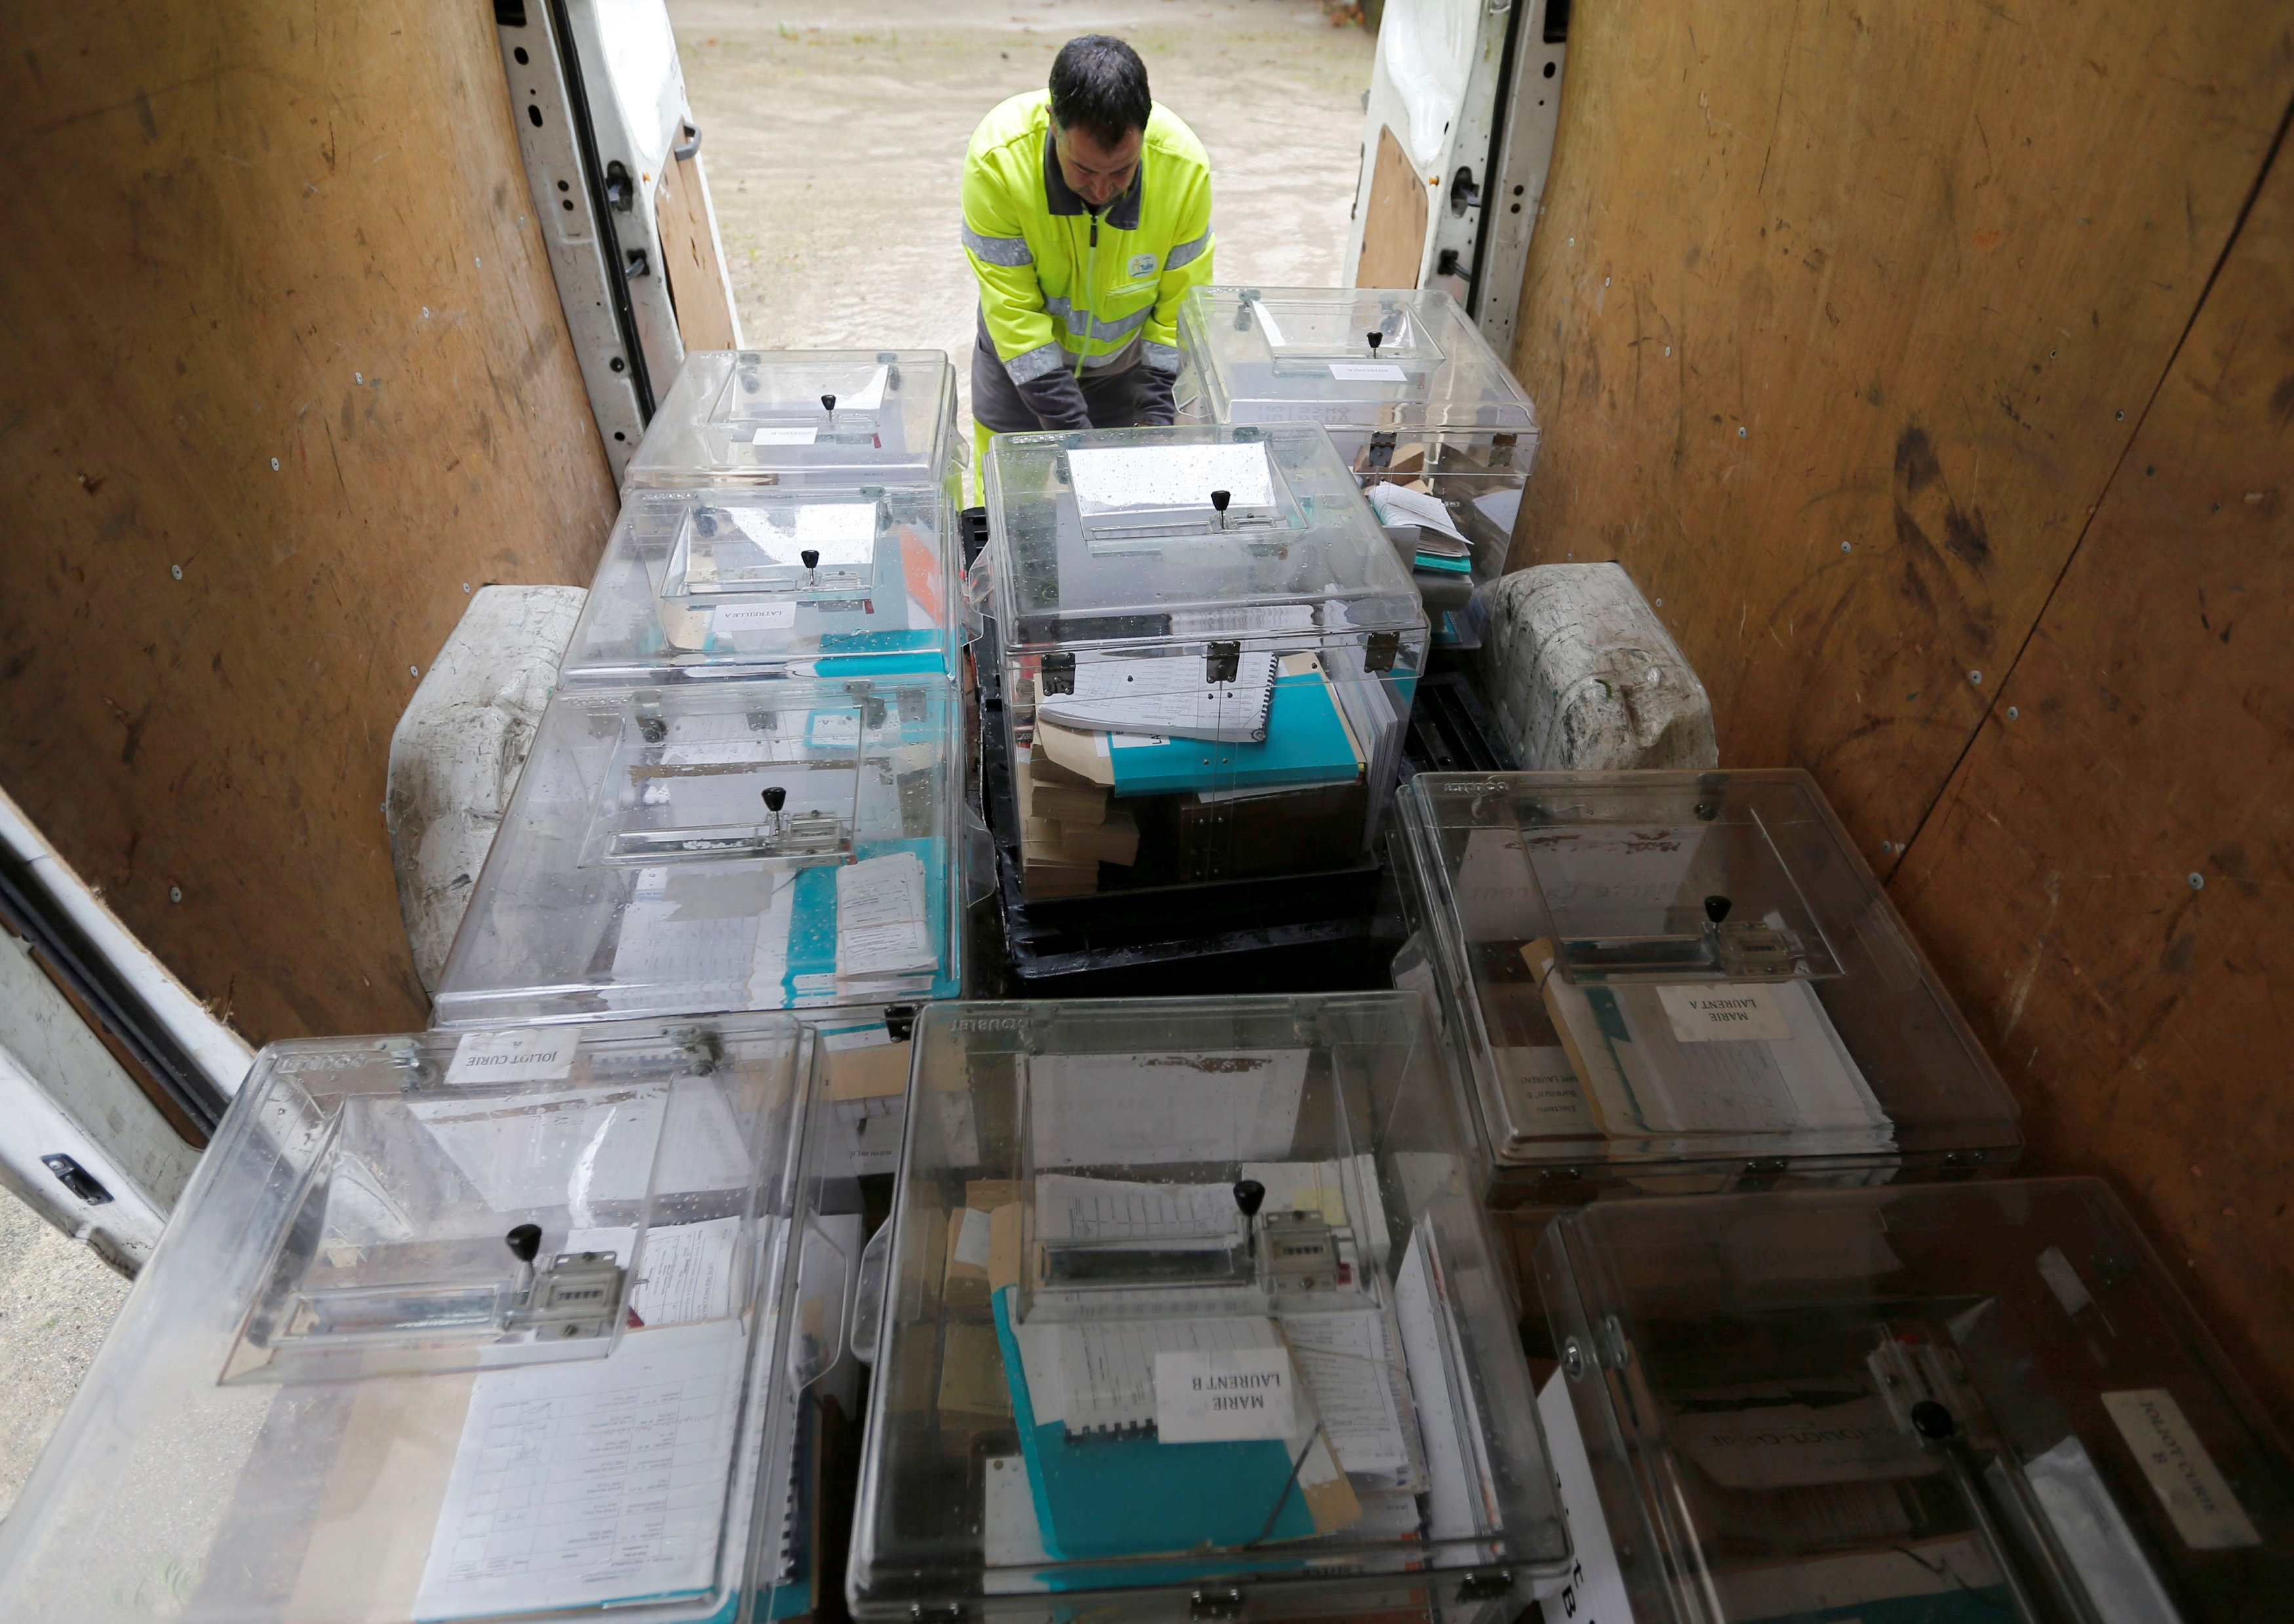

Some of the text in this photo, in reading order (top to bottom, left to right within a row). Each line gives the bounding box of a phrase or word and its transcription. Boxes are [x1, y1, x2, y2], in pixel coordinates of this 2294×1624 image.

[1150, 733, 1162, 744] LA
[1689, 999, 1757, 1011] LAURENT A
[1709, 1011, 1748, 1022] MARIE
[466, 1051, 558, 1066] JOLIOT CURIE
[1192, 1373, 1280, 1391] LAURENT B
[1213, 1395, 1264, 1412] MARIE
